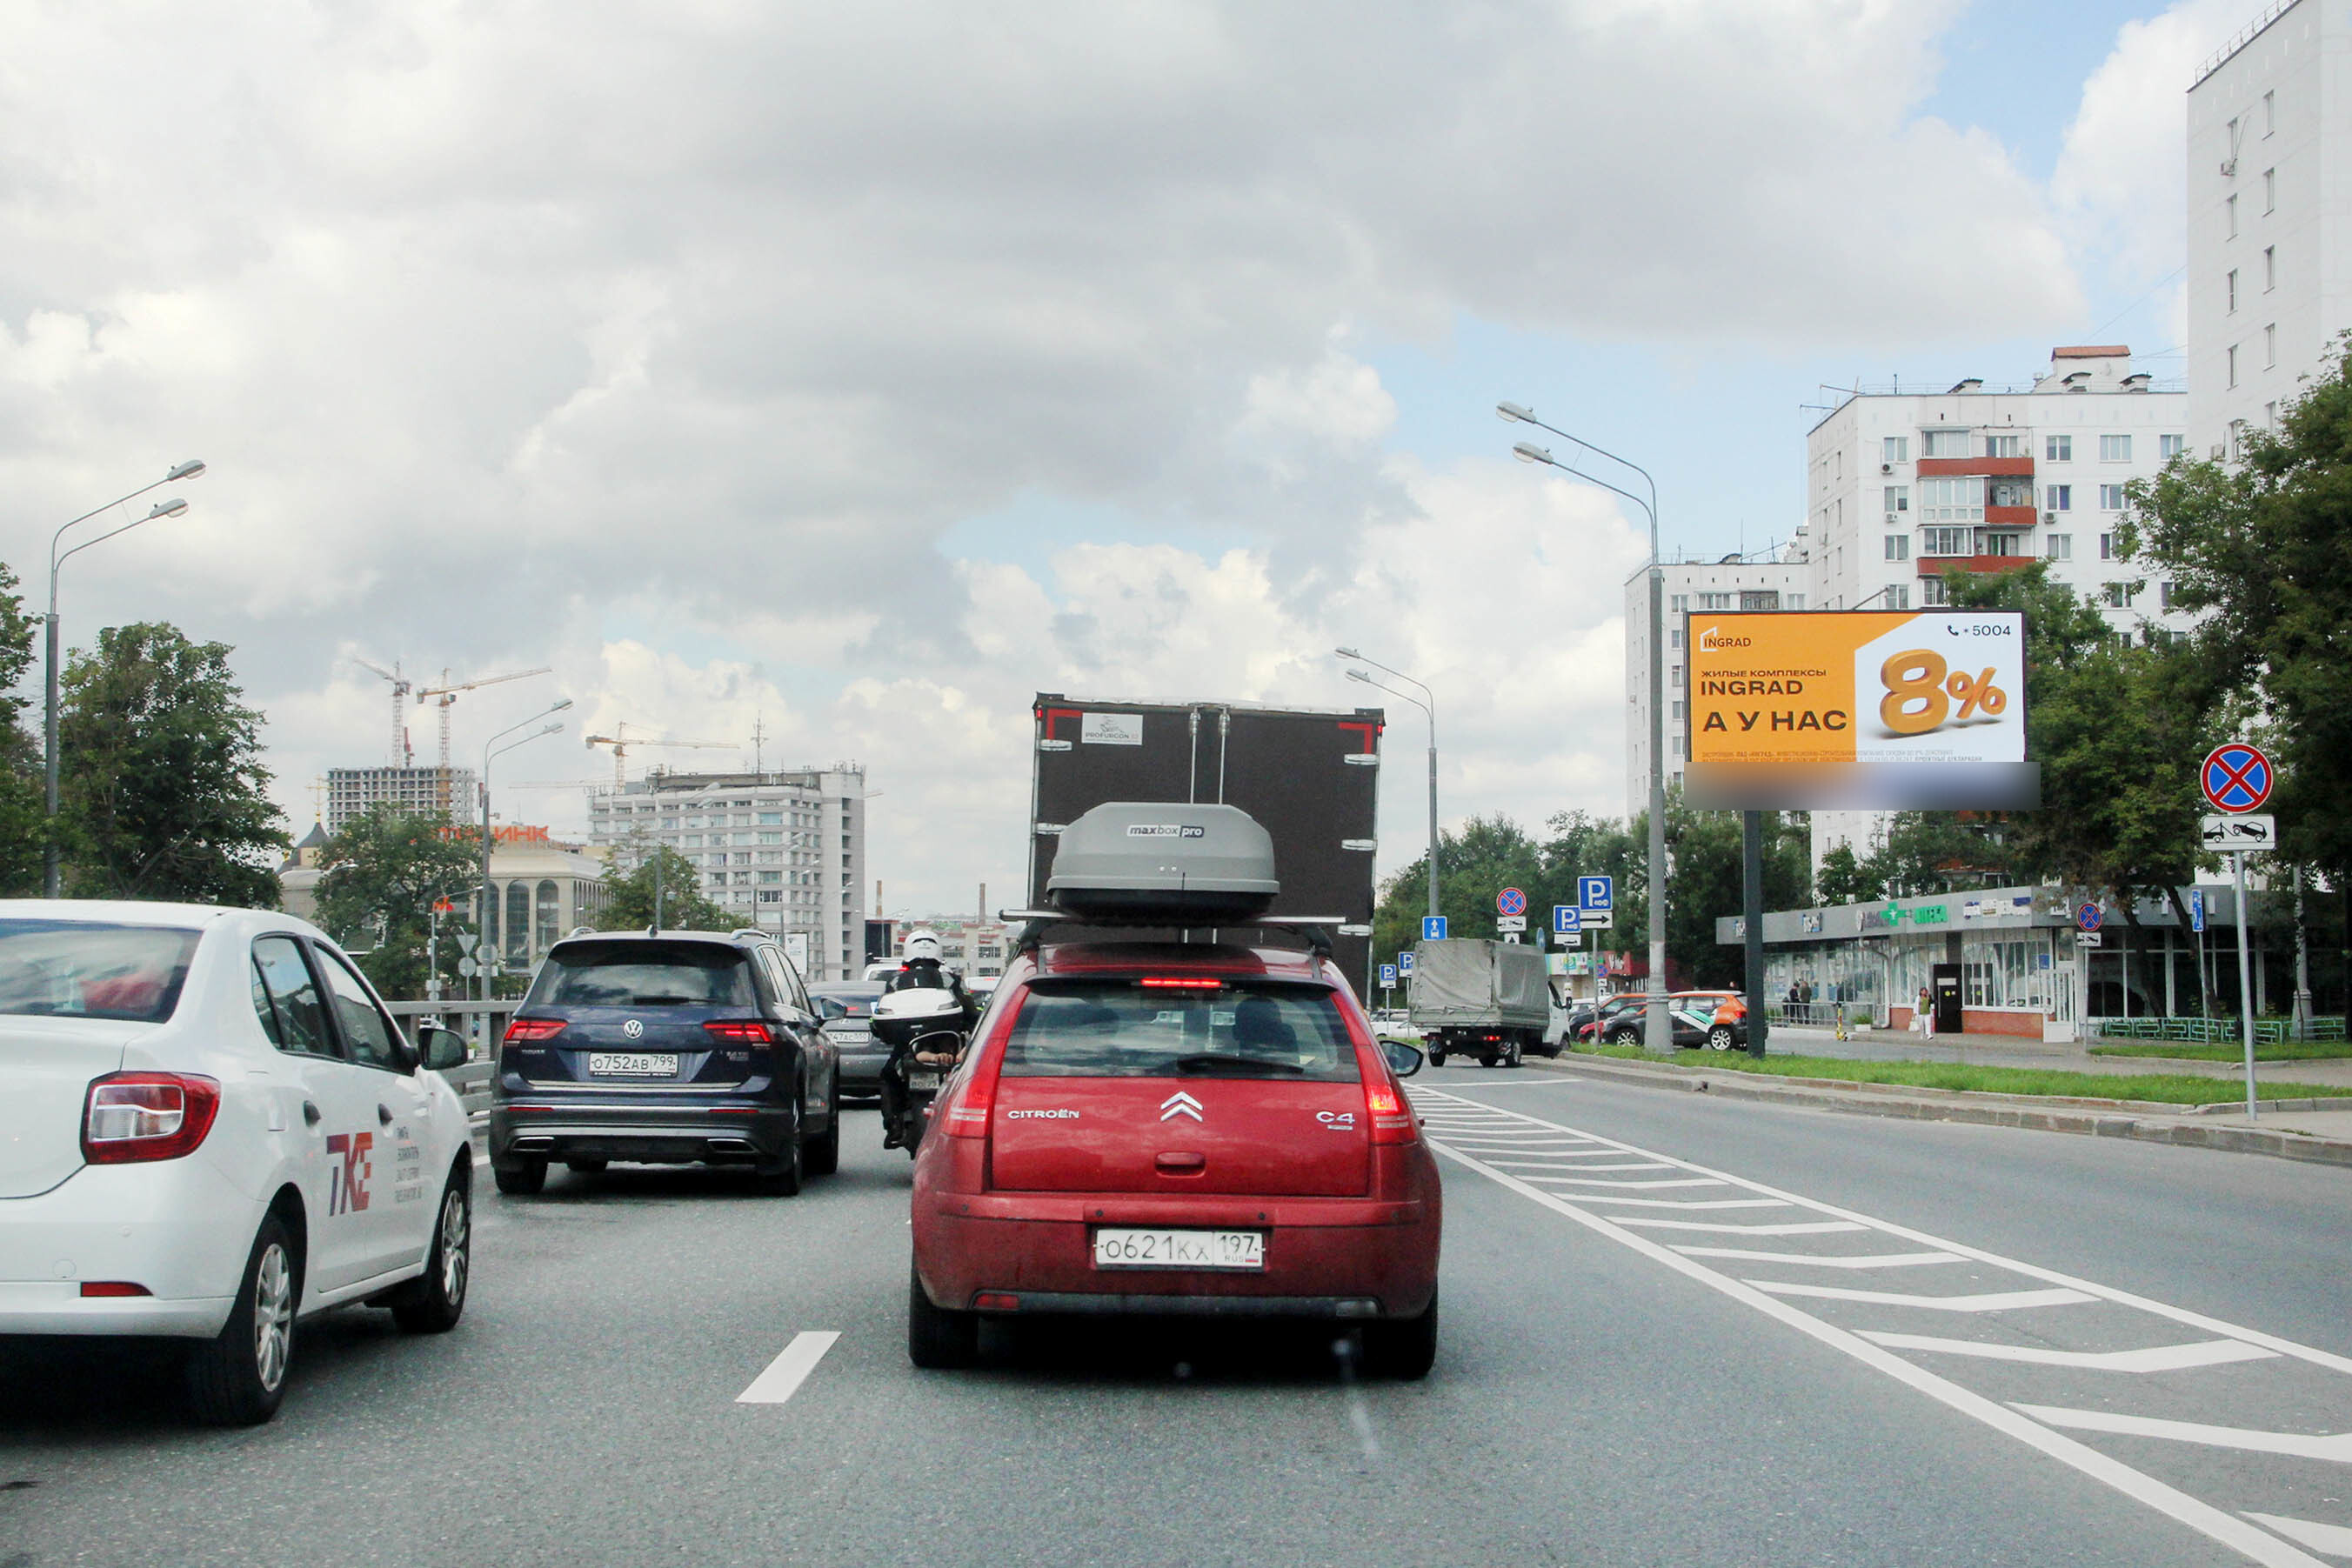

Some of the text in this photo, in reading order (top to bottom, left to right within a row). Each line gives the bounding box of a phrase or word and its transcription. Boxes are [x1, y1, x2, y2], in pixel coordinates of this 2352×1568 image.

[1704, 637, 1752, 648] INGRAD
[1701, 680, 1803, 696] INGRAD
[1880, 648, 2007, 734] 8%
[1702, 710, 1848, 732] А У НАС
[1008, 1109, 1079, 1119] CITROËN
[1315, 1111, 1355, 1124] C4
[1219, 1235, 1254, 1254] 197
